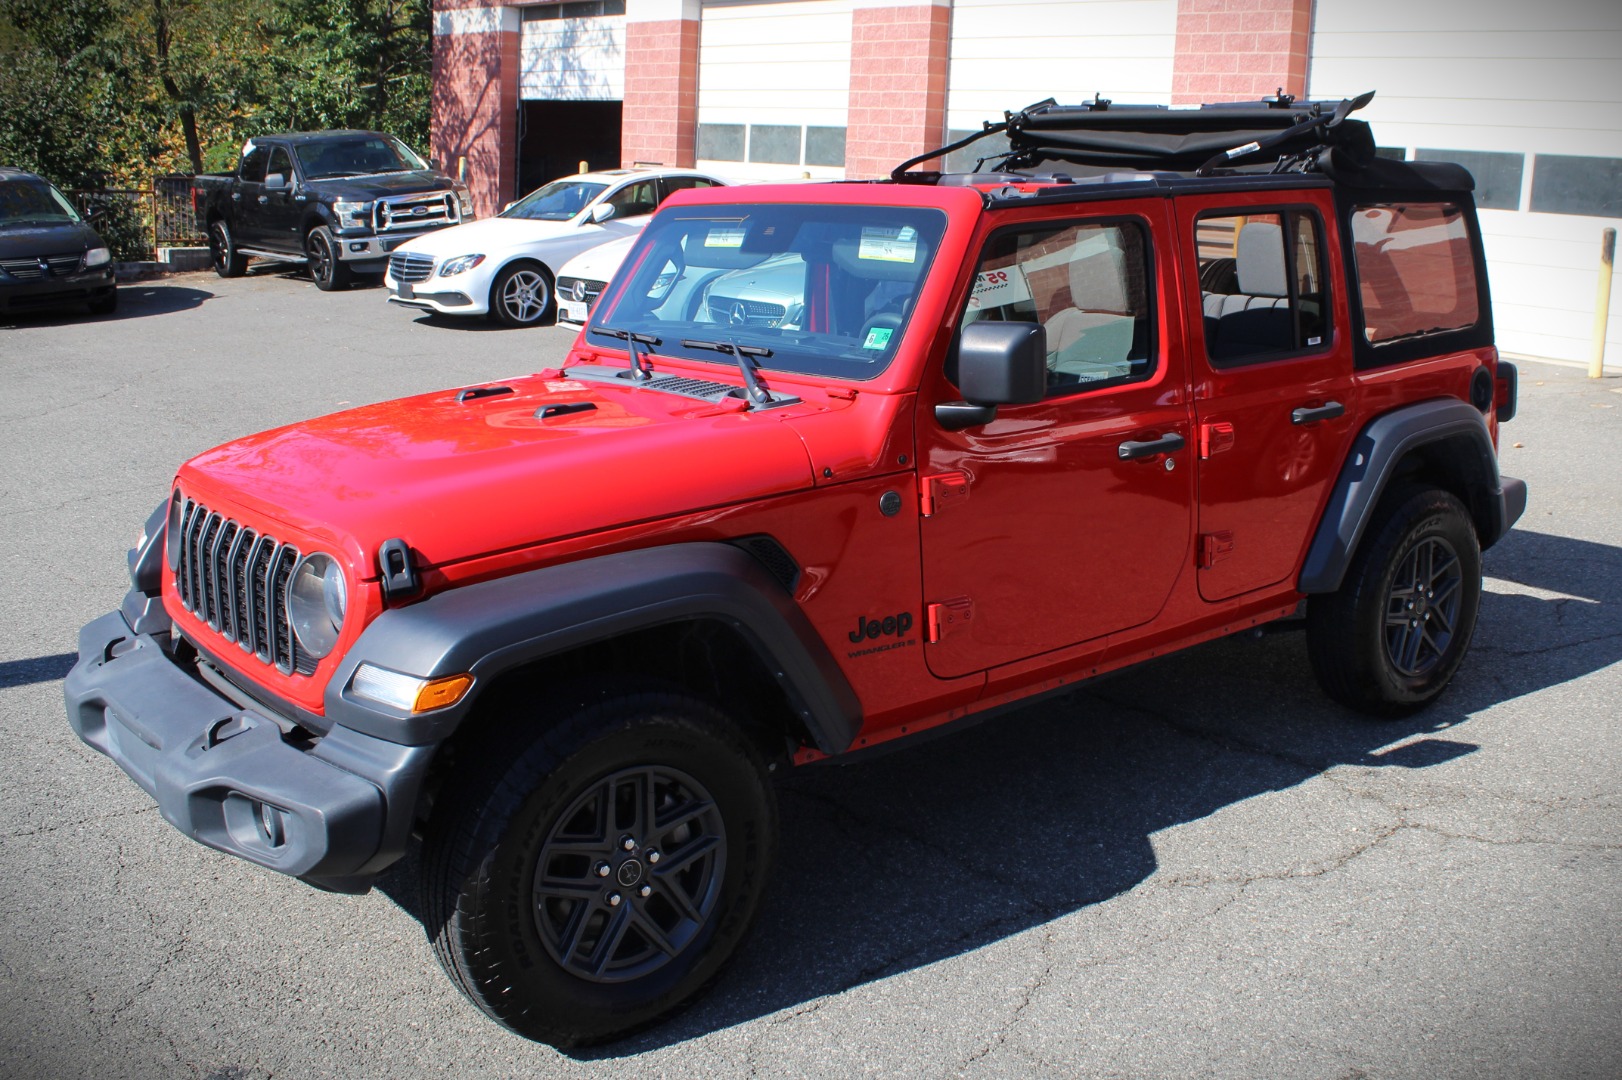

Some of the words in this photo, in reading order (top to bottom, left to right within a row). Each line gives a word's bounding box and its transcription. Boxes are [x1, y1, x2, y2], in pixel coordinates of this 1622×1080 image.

[848, 612, 913, 643] Jeep
[847, 641, 906, 658] WRANGLER
[720, 820, 757, 937] NEXEN
